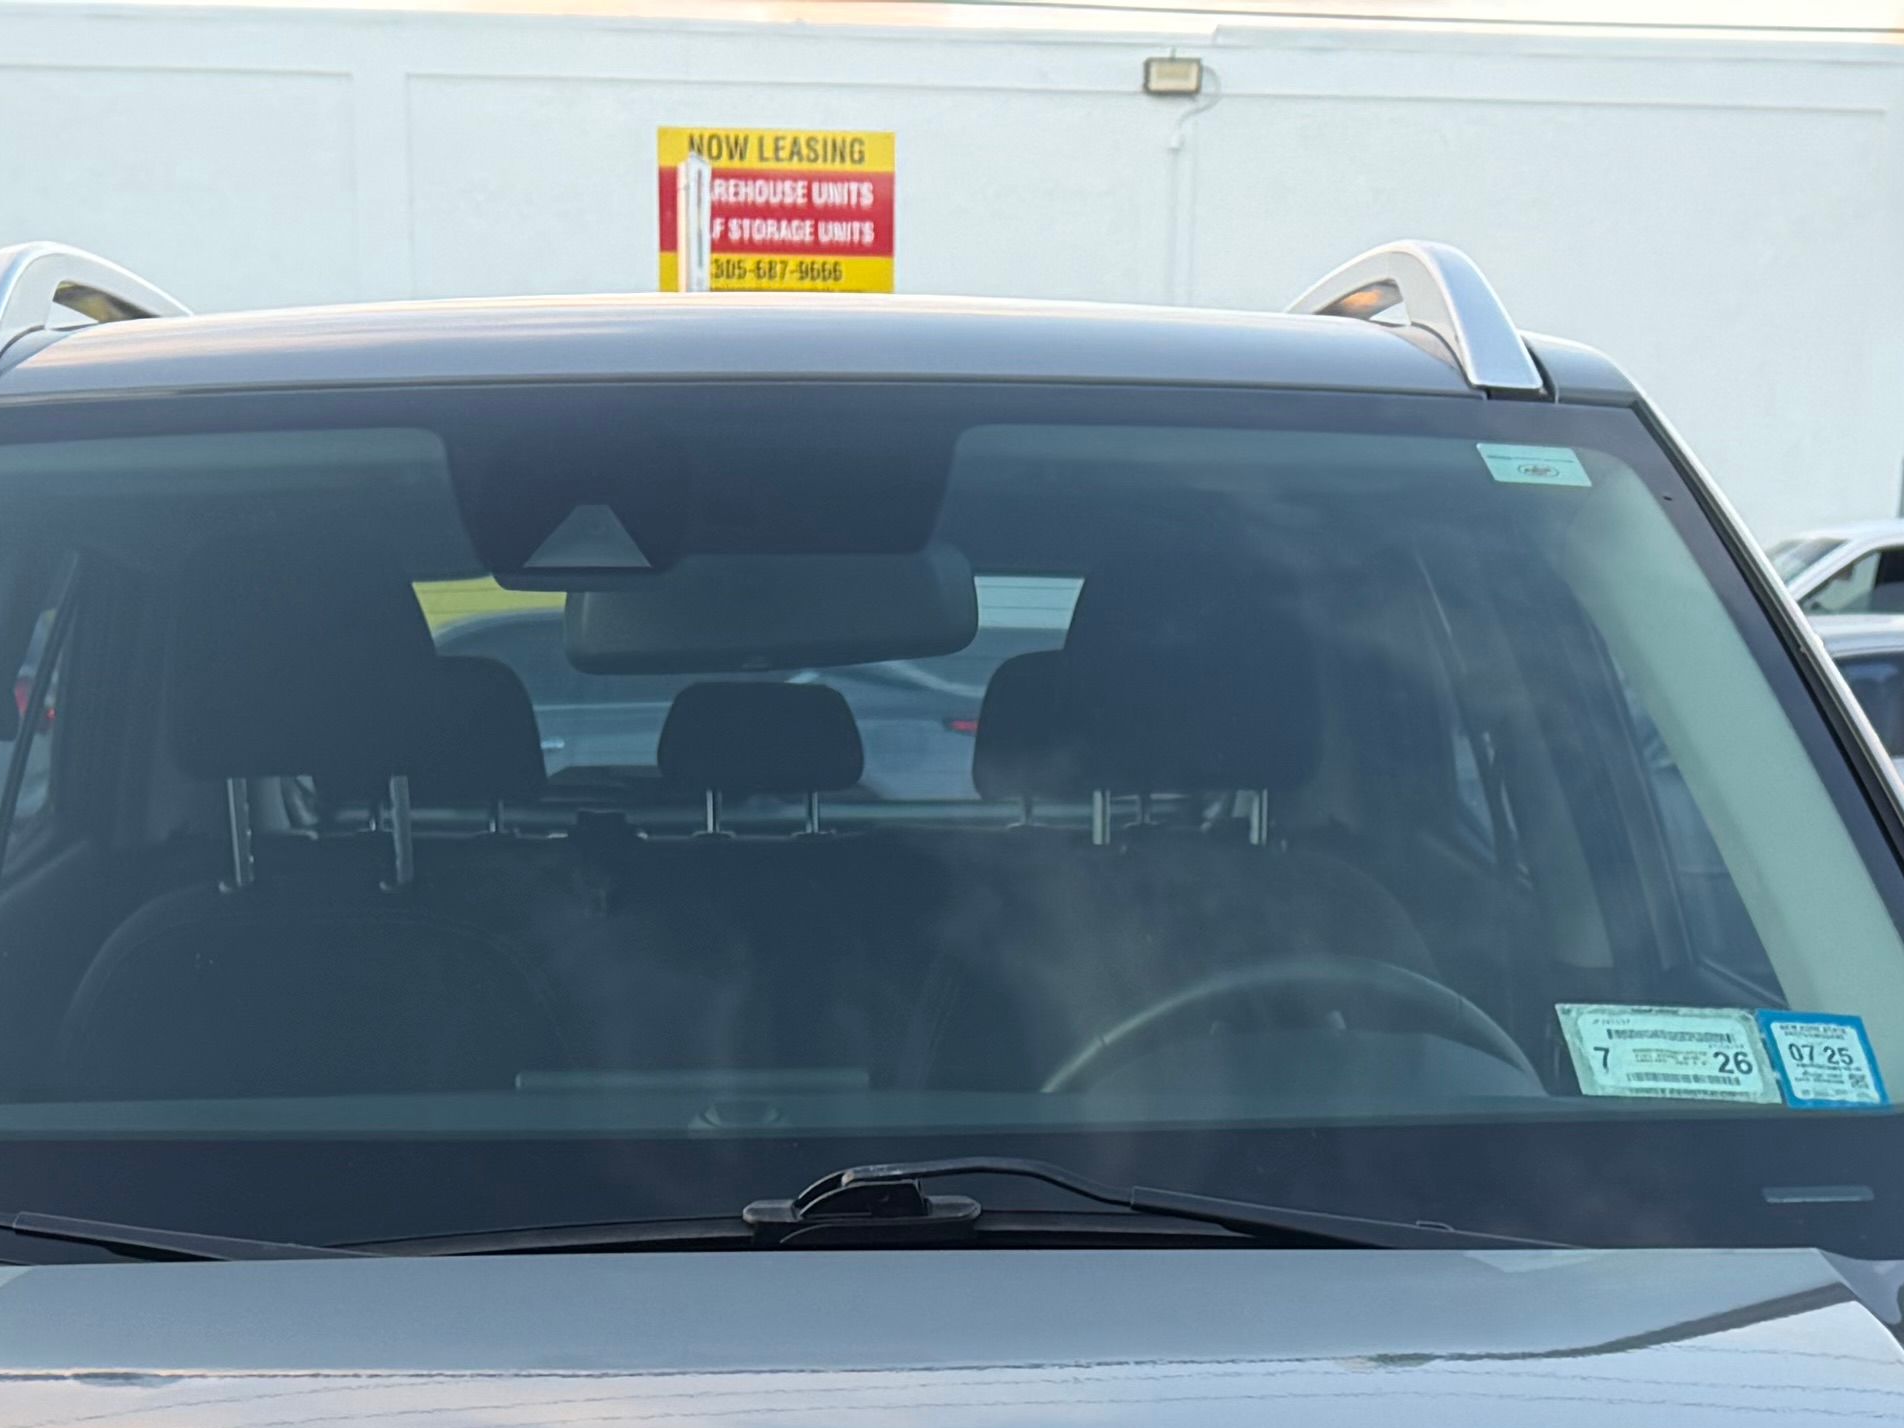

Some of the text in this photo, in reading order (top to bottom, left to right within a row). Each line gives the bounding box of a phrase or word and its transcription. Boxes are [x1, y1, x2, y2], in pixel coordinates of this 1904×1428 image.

[688, 133, 866, 166] NOW LEASING
[812, 180, 874, 208] UNITS
[727, 219, 814, 243] STORAGE
[818, 221, 874, 245] UNITS
[1593, 1046, 1610, 1073] 7
[1712, 1051, 1754, 1075] 26
[1787, 1043, 1854, 1066] 07 25
